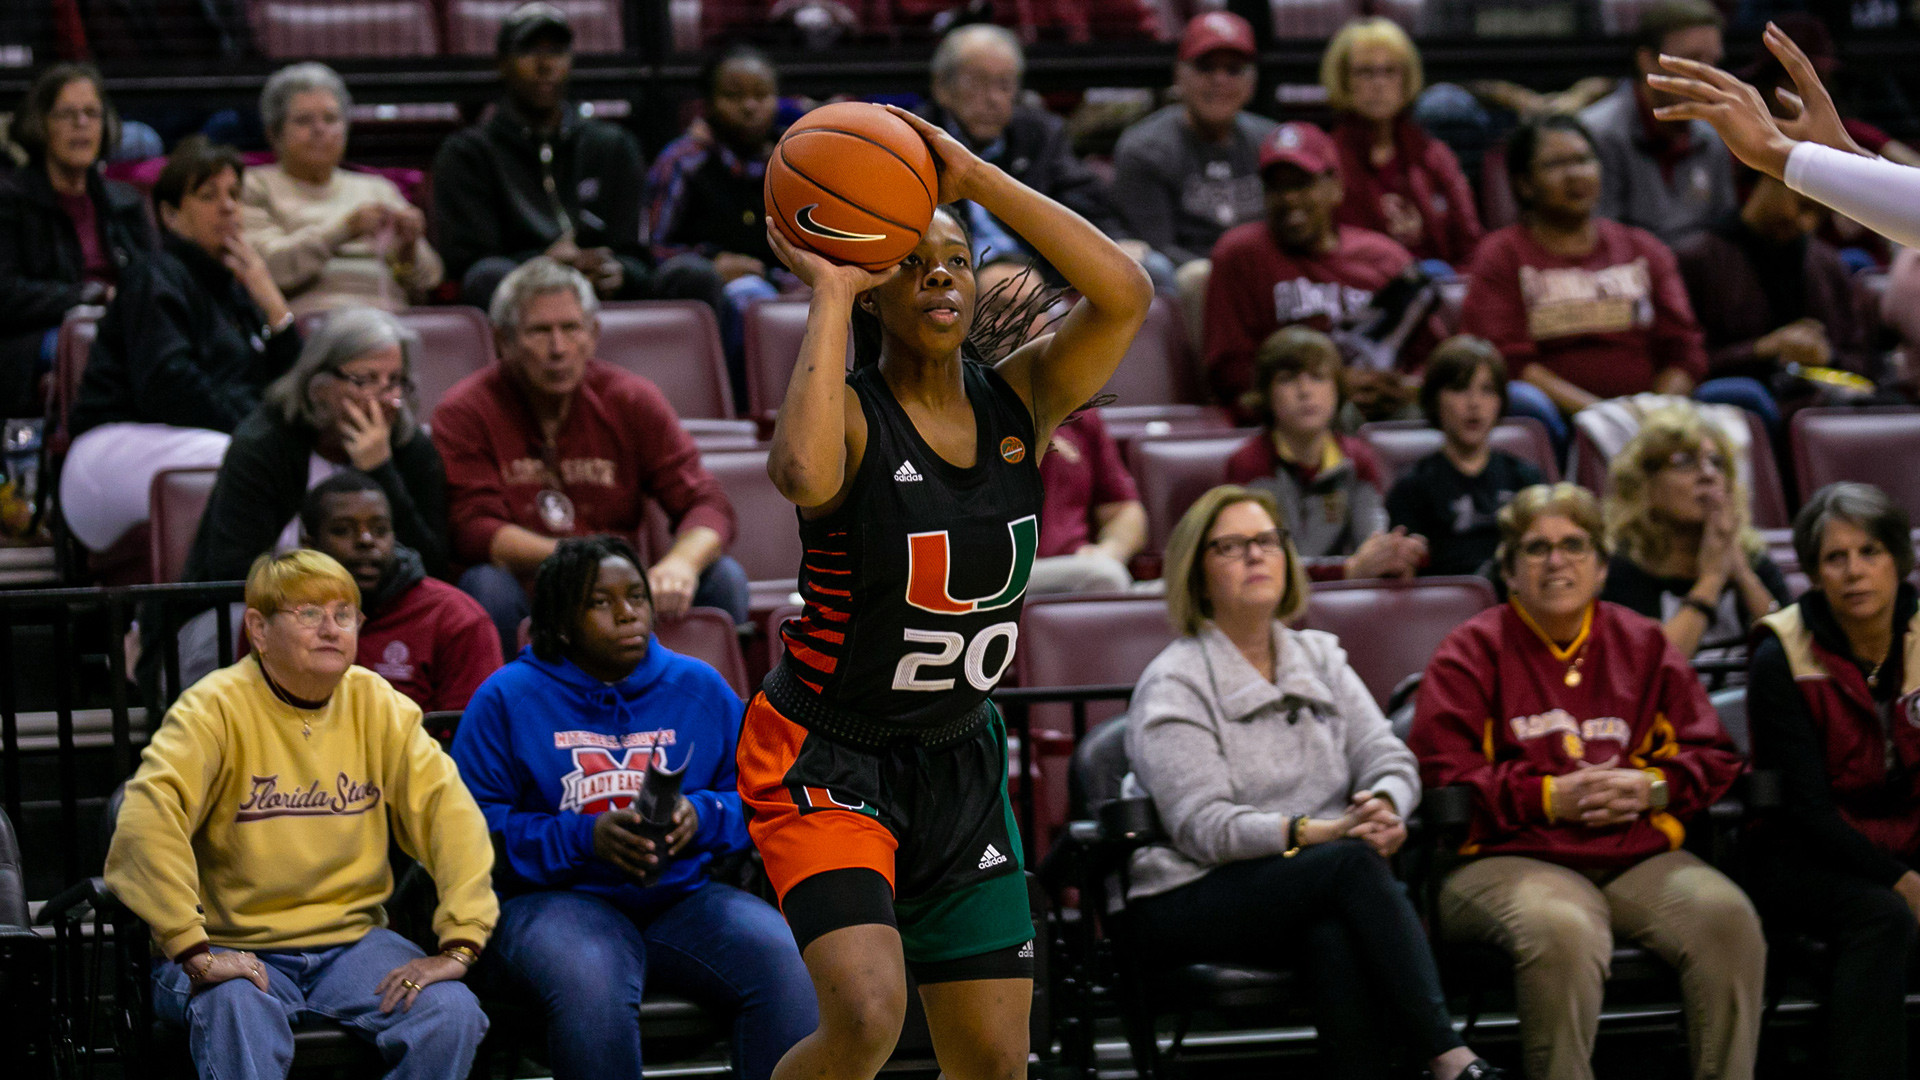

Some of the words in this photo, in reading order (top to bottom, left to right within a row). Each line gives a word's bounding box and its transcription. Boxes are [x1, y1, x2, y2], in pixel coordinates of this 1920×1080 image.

[893, 473, 924, 482] adidas
[905, 514, 1039, 616] U
[891, 621, 1019, 691] 20
[238, 774, 331, 811] Florida
[580, 774, 613, 800] LADY
[618, 772, 643, 792] EAG
[978, 854, 1008, 870] adidas
